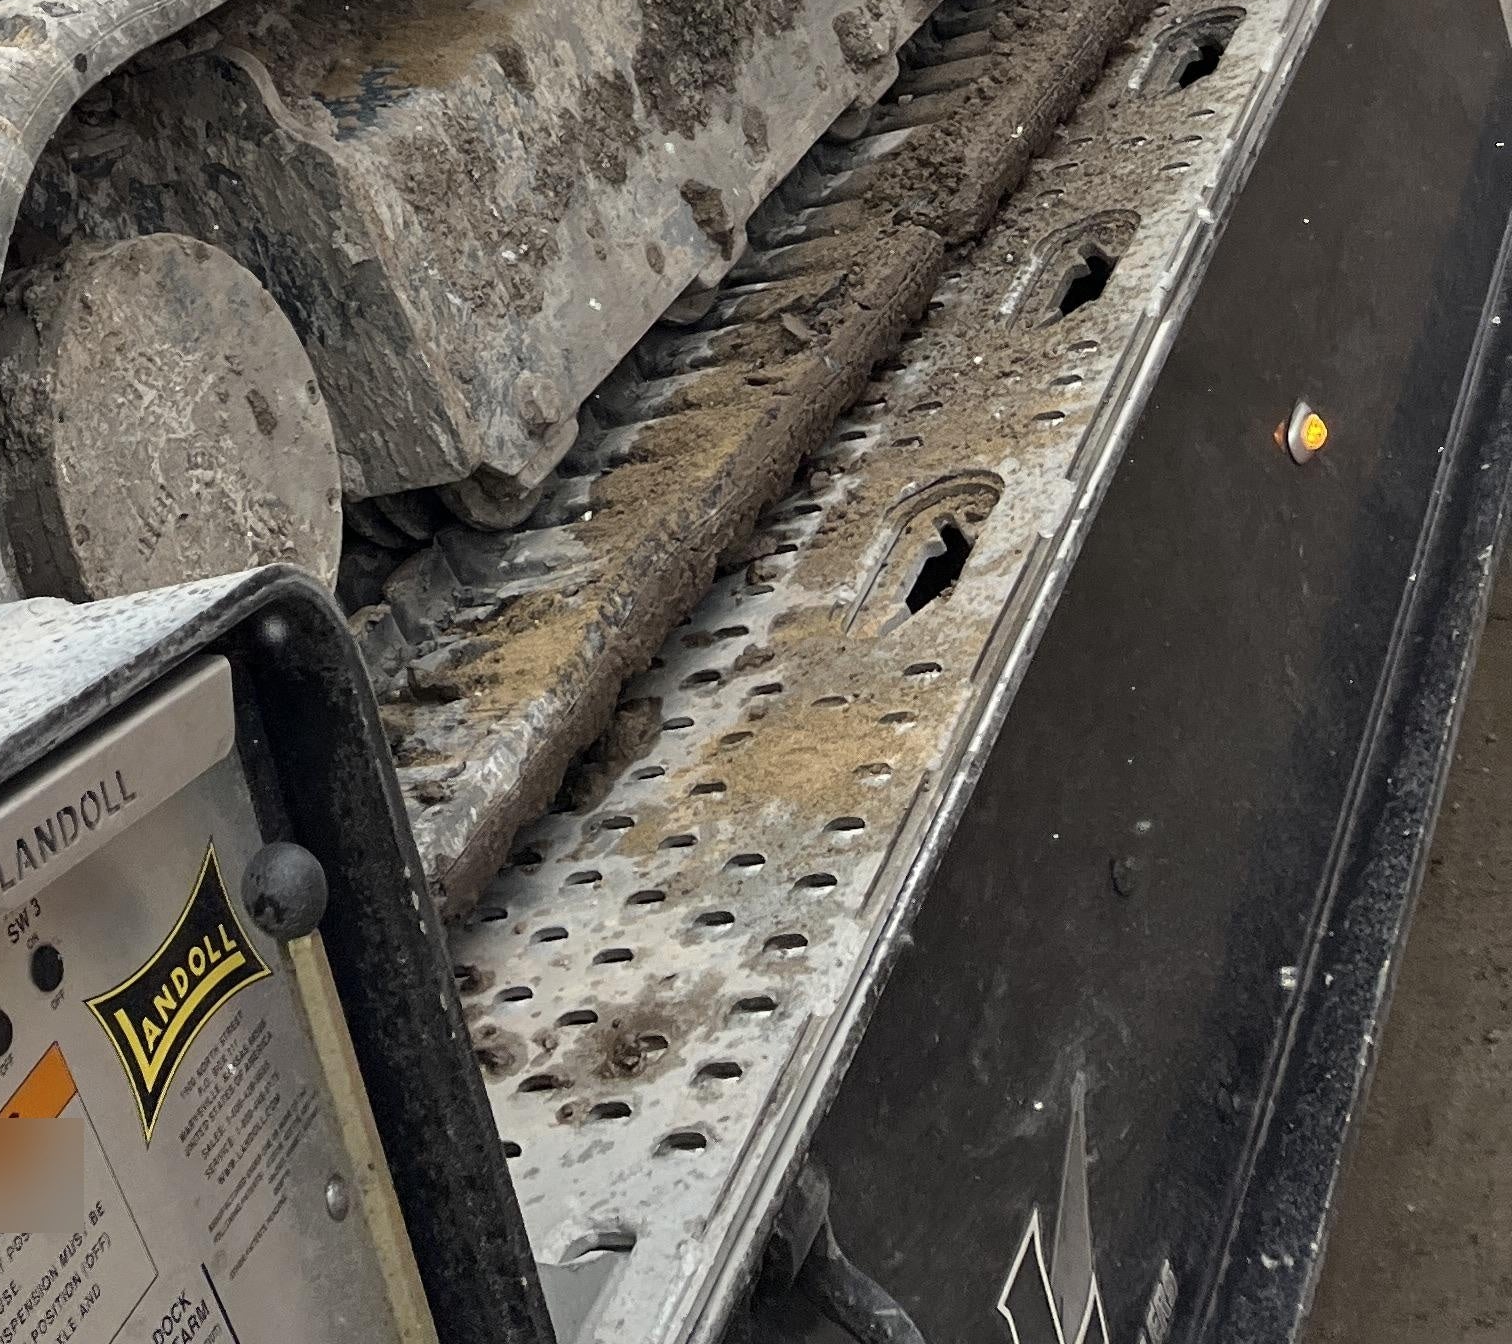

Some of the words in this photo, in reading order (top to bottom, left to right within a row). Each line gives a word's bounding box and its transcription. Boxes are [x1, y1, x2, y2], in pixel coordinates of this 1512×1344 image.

[7, 907, 30, 944] SW
[30, 897, 41, 917] 3
[114, 923, 246, 1094] LANDOLL
[57, 1226, 87, 1269] MUS
[88, 1200, 106, 1226] BE
[30, 1271, 82, 1344] POSITION
[79, 1282, 102, 1320] AND
[152, 1288, 192, 1344] DOCK
